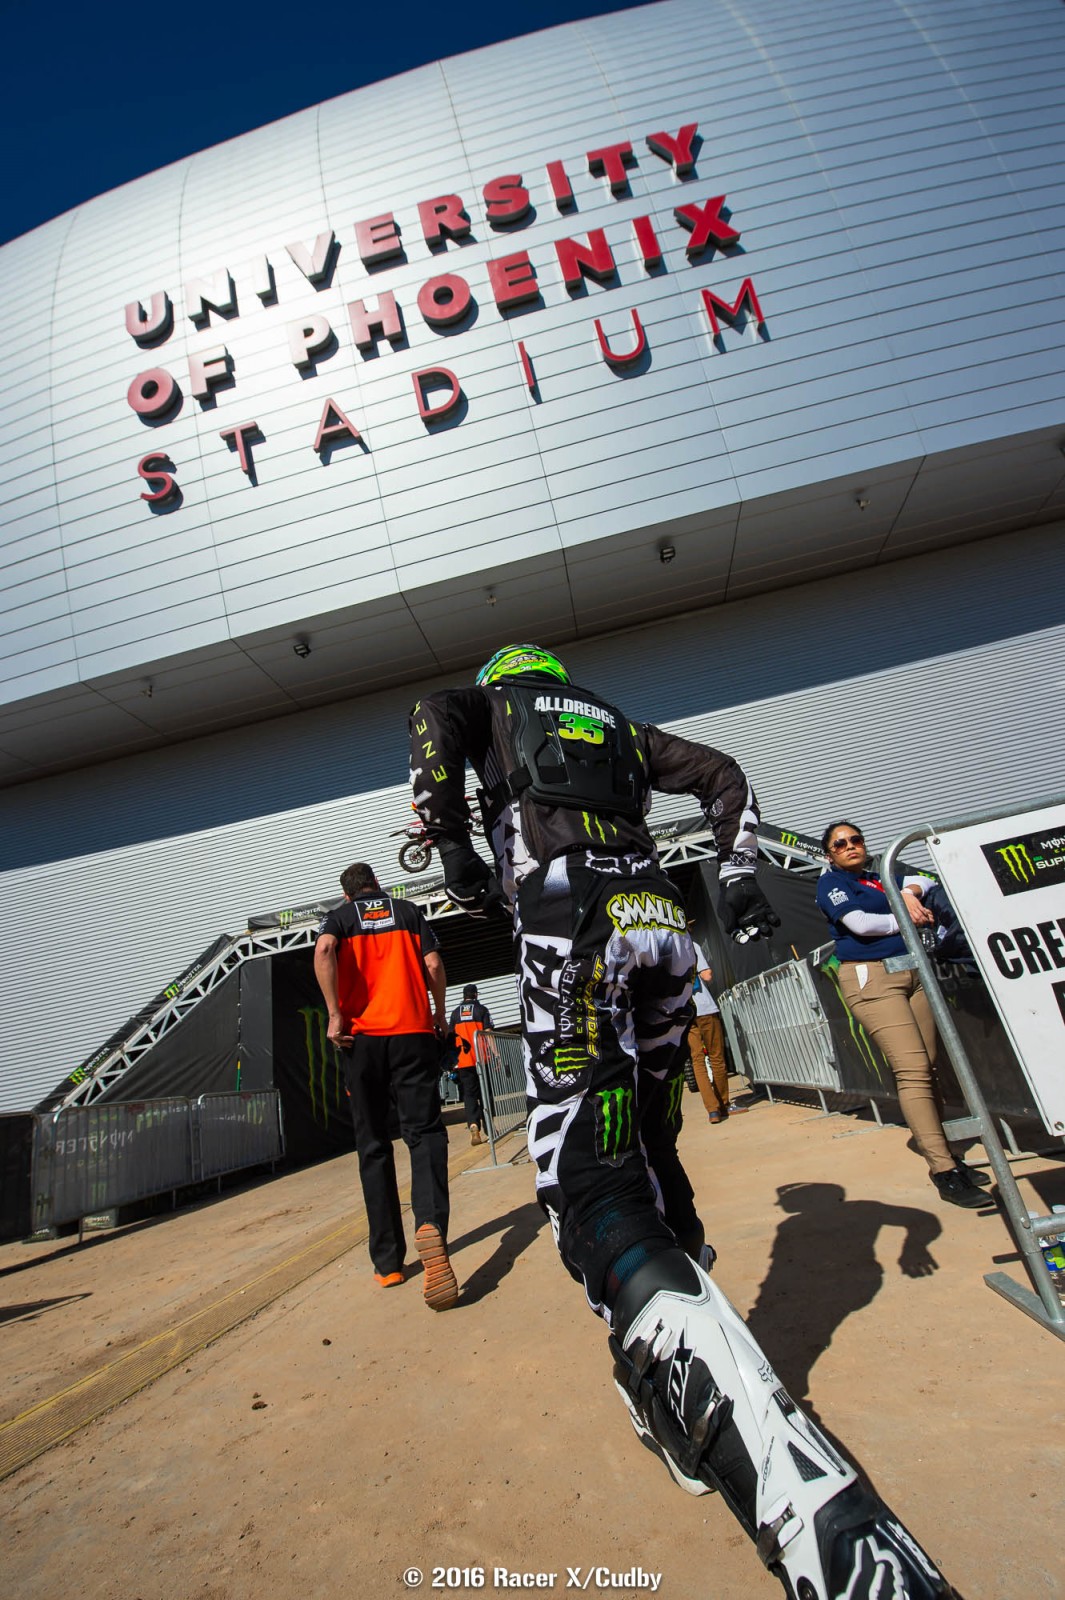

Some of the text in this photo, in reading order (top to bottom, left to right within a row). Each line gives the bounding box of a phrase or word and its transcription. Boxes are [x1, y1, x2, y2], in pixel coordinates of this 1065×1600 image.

[125, 123, 702, 343] UNIVERSITY
[127, 194, 741, 420] OF PHOENIX
[140, 277, 766, 503] STADIUM
[534, 696, 616, 729] ALLDREDGE
[558, 713, 604, 745] 35
[1035, 856, 1065, 869] SUP
[609, 895, 686, 931] SMALLS
[559, 961, 581, 1045] MONSTER
